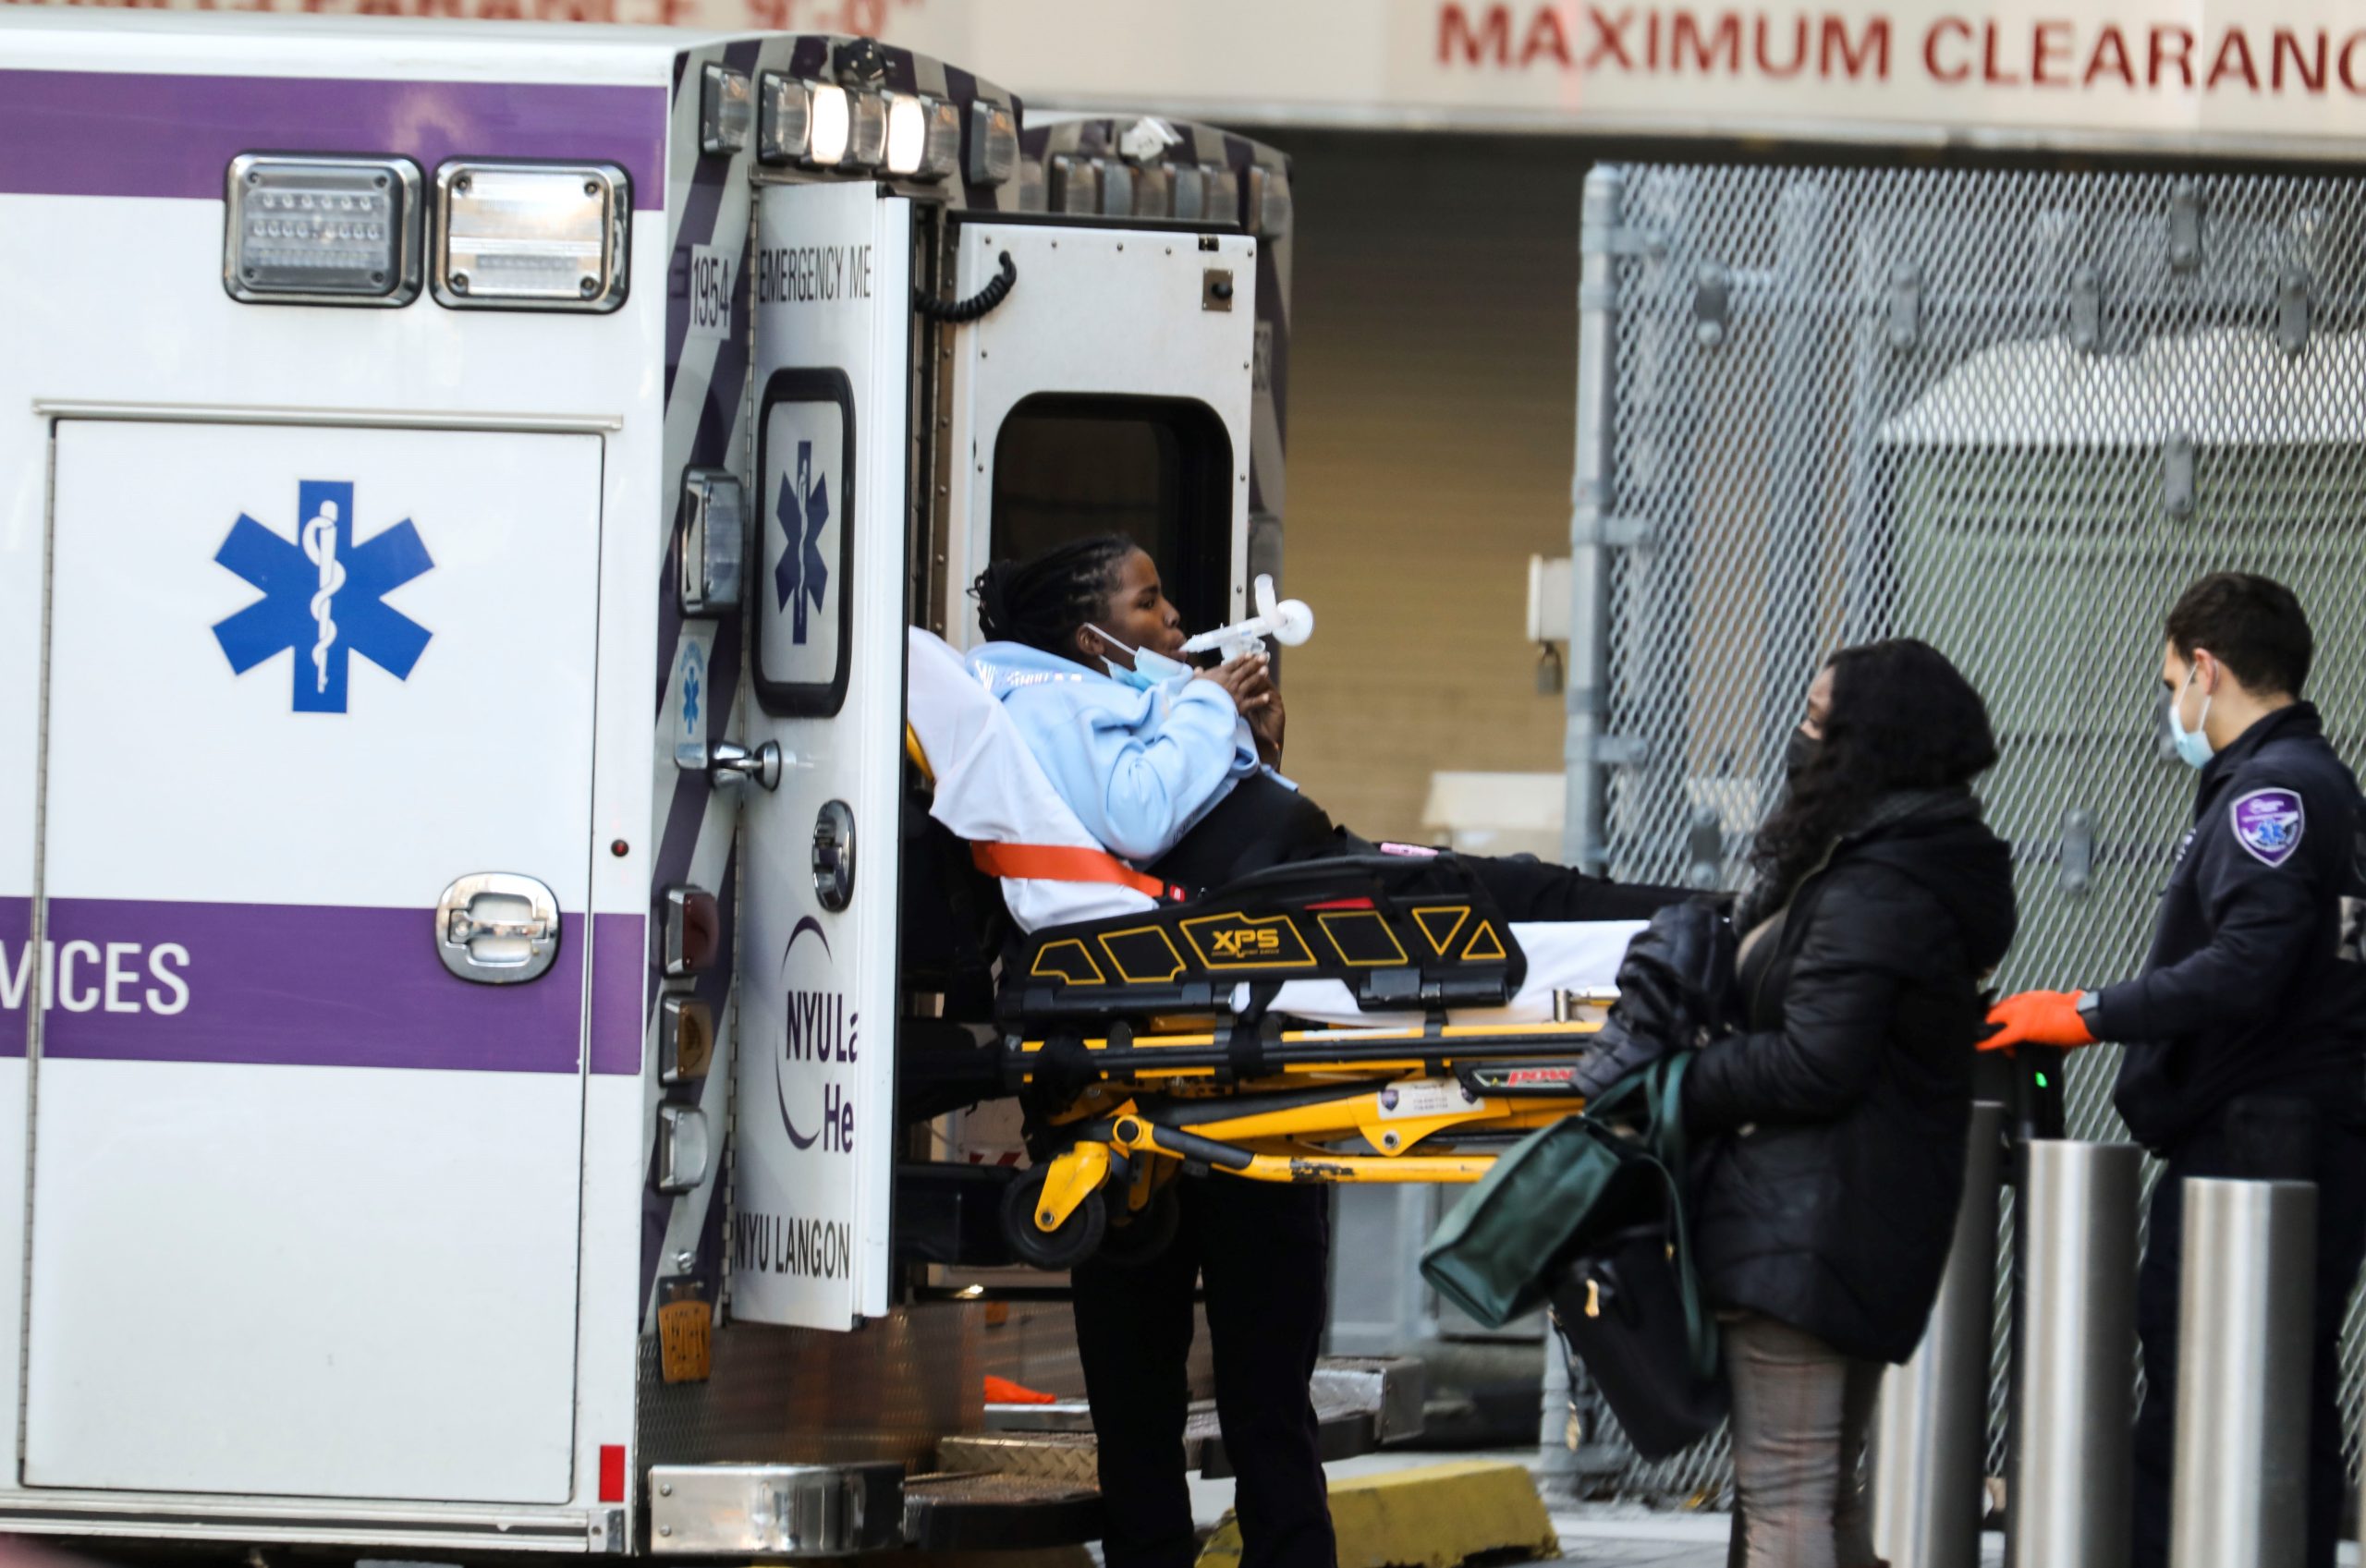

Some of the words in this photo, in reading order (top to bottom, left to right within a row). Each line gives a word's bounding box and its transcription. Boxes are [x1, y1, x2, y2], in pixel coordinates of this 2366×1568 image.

[1436, 3, 1894, 81] MAXIMUM
[693, 256, 729, 328] 1954
[759, 245, 844, 303] EMERGENCY
[848, 244, 872, 299] ME
[1212, 928, 1280, 954] XPS
[0, 939, 190, 1015] VICES
[786, 990, 833, 1062] NYU
[823, 1083, 854, 1154] He
[735, 1210, 770, 1271] NYU
[774, 1215, 850, 1279] LANGON
